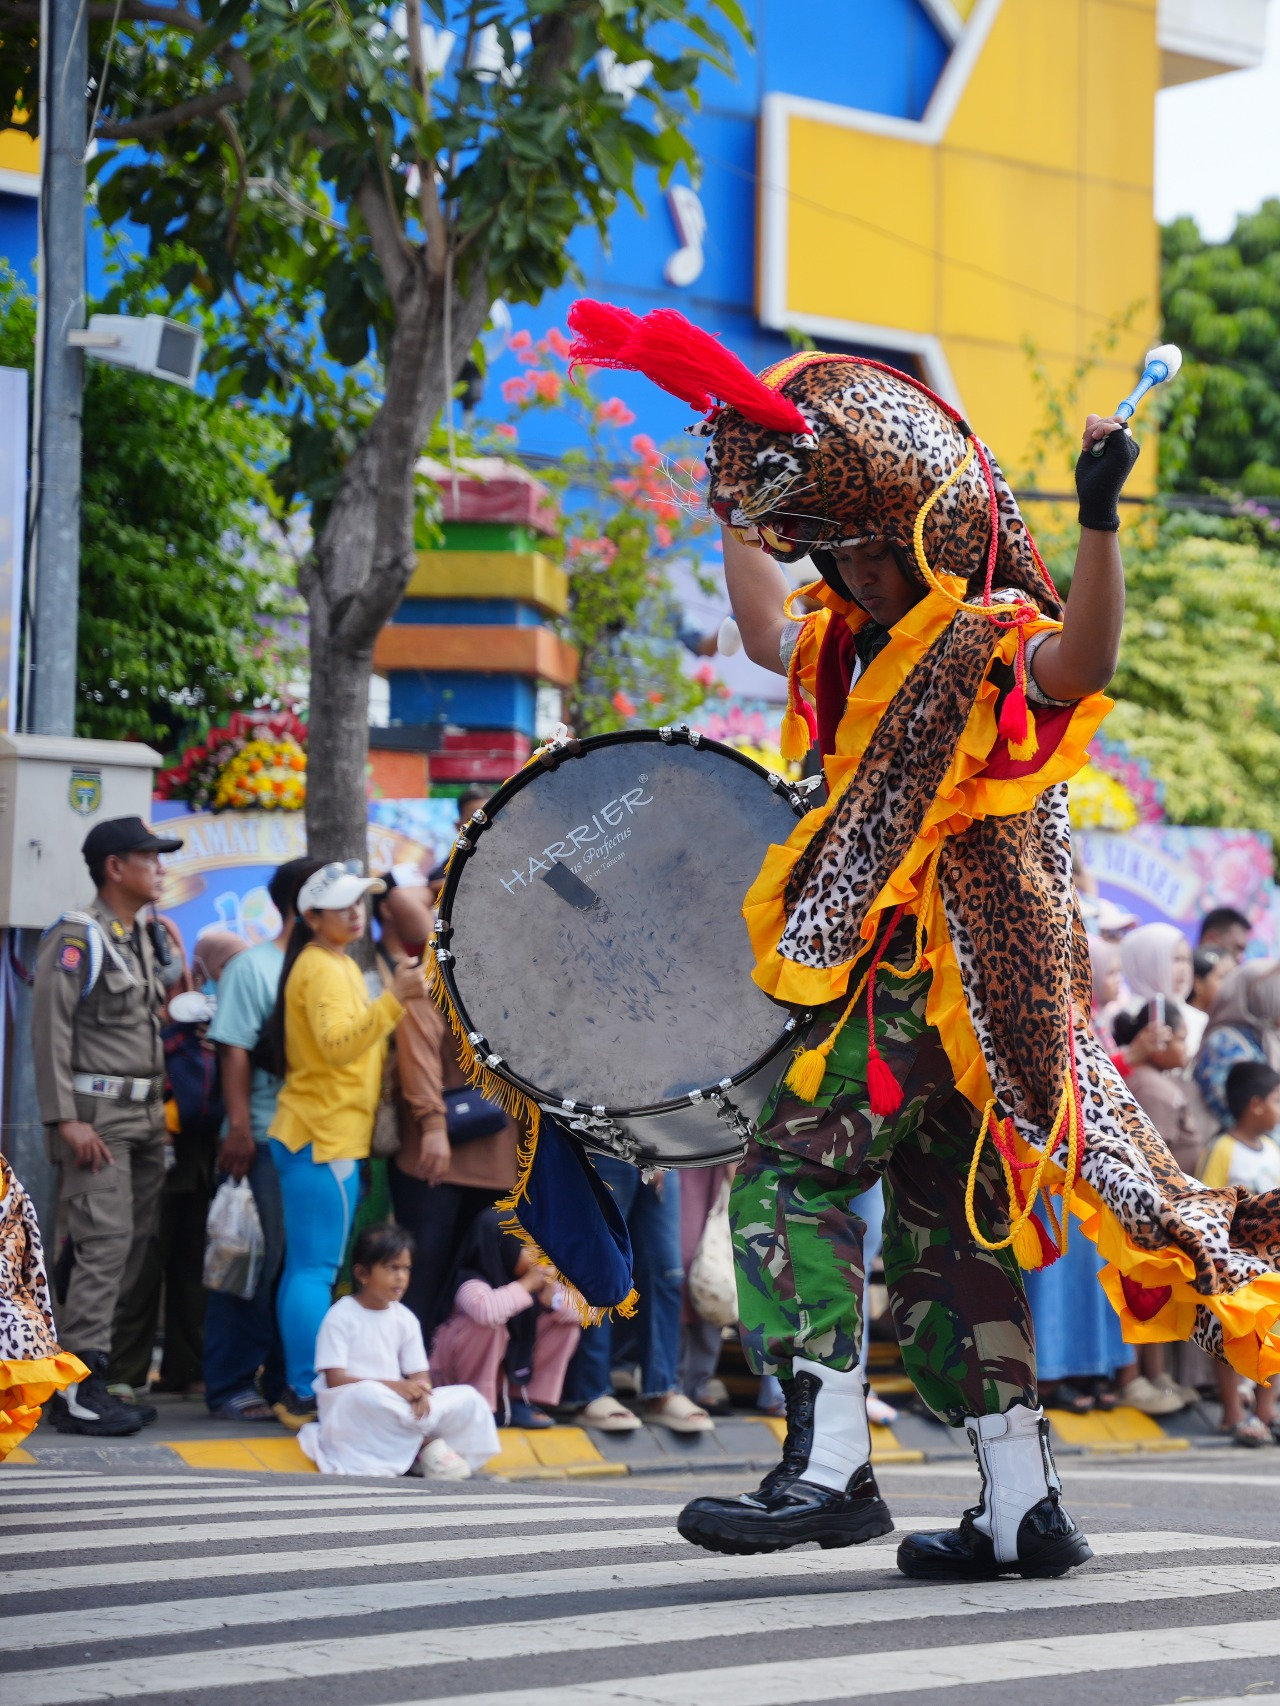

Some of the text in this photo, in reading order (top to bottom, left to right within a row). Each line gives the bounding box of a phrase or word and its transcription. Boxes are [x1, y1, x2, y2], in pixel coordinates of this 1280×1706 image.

[500, 787, 654, 894] HARRIER
[570, 827, 632, 875] us Perfectus
[600, 851, 626, 870] Taiwan
